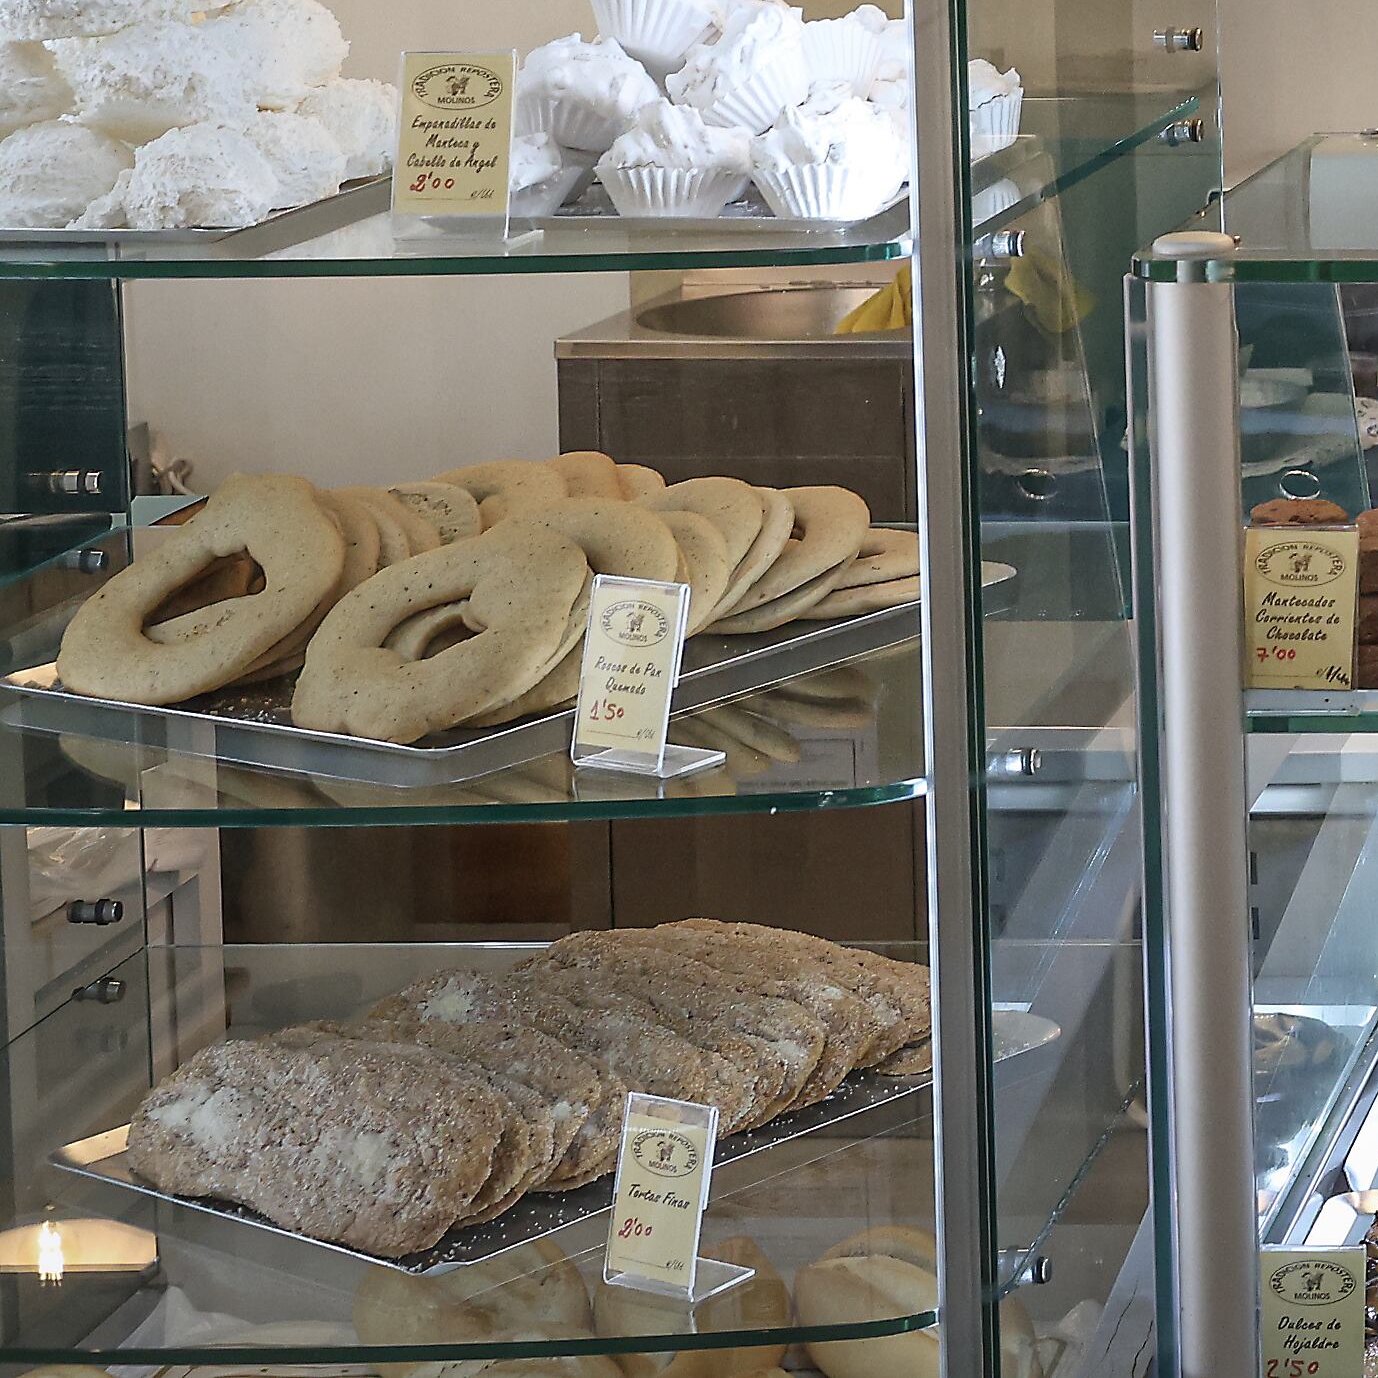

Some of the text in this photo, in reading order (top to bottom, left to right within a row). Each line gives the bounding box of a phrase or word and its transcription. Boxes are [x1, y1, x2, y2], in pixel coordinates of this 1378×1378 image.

[437, 96, 475, 104] MOLINOS
[412, 114, 496, 133] Empanadillas de
[426, 134, 469, 148] Manteca
[407, 153, 446, 167] Cabello
[450, 155, 461, 167] de
[1262, 592, 1336, 608] Mantecados
[1255, 609, 1340, 625] Corrientes de
[1266, 626, 1328, 641] Chocolate
[595, 656, 662, 678] Roscos de Pan
[605, 677, 646, 696] Quemado
[628, 1183, 691, 1210] Tortas Finas
[1278, 1316, 1341, 1330] Dulces de
[1284, 1334, 1339, 1355] Hojaldre
